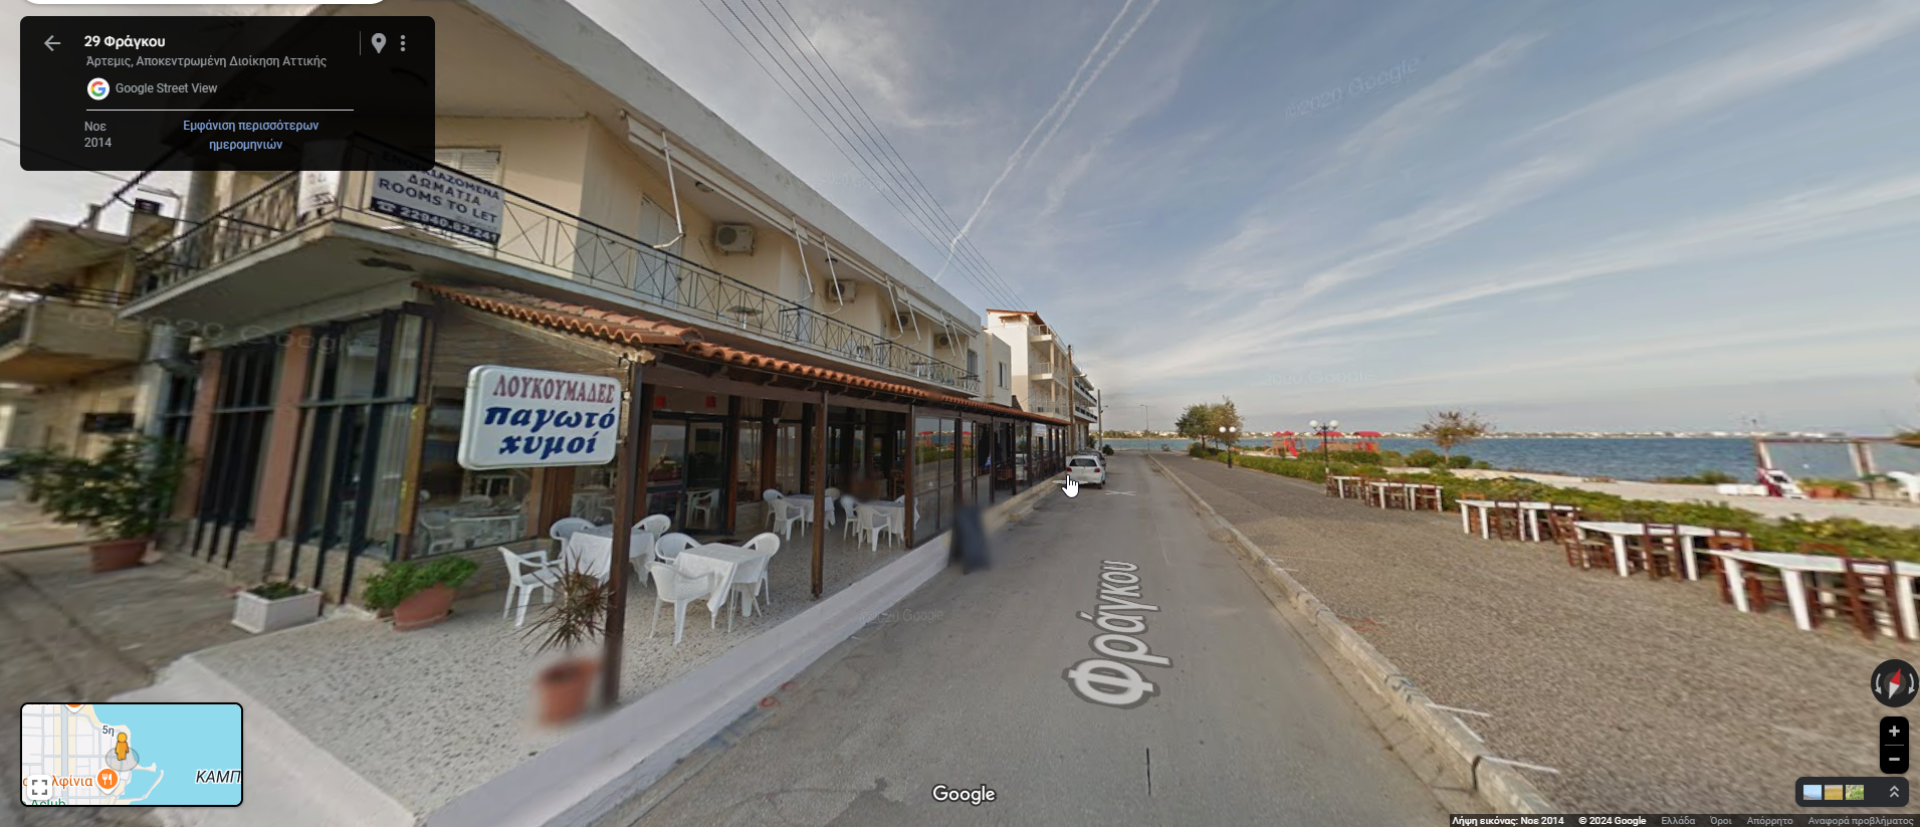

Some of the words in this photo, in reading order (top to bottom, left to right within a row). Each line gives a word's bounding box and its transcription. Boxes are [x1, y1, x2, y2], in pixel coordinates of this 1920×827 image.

[378, 177, 442, 207] ROOMS
[445, 199, 468, 215] TO
[472, 207, 499, 224] LET
[407, 173, 482, 206] ΔΩΜΑΤΙΑ
[493, 374, 616, 404] ΛΟΥΚΟΥΜΑΔΕΣ
[484, 406, 616, 433] παγωτό
[499, 430, 600, 460] χυμοί
